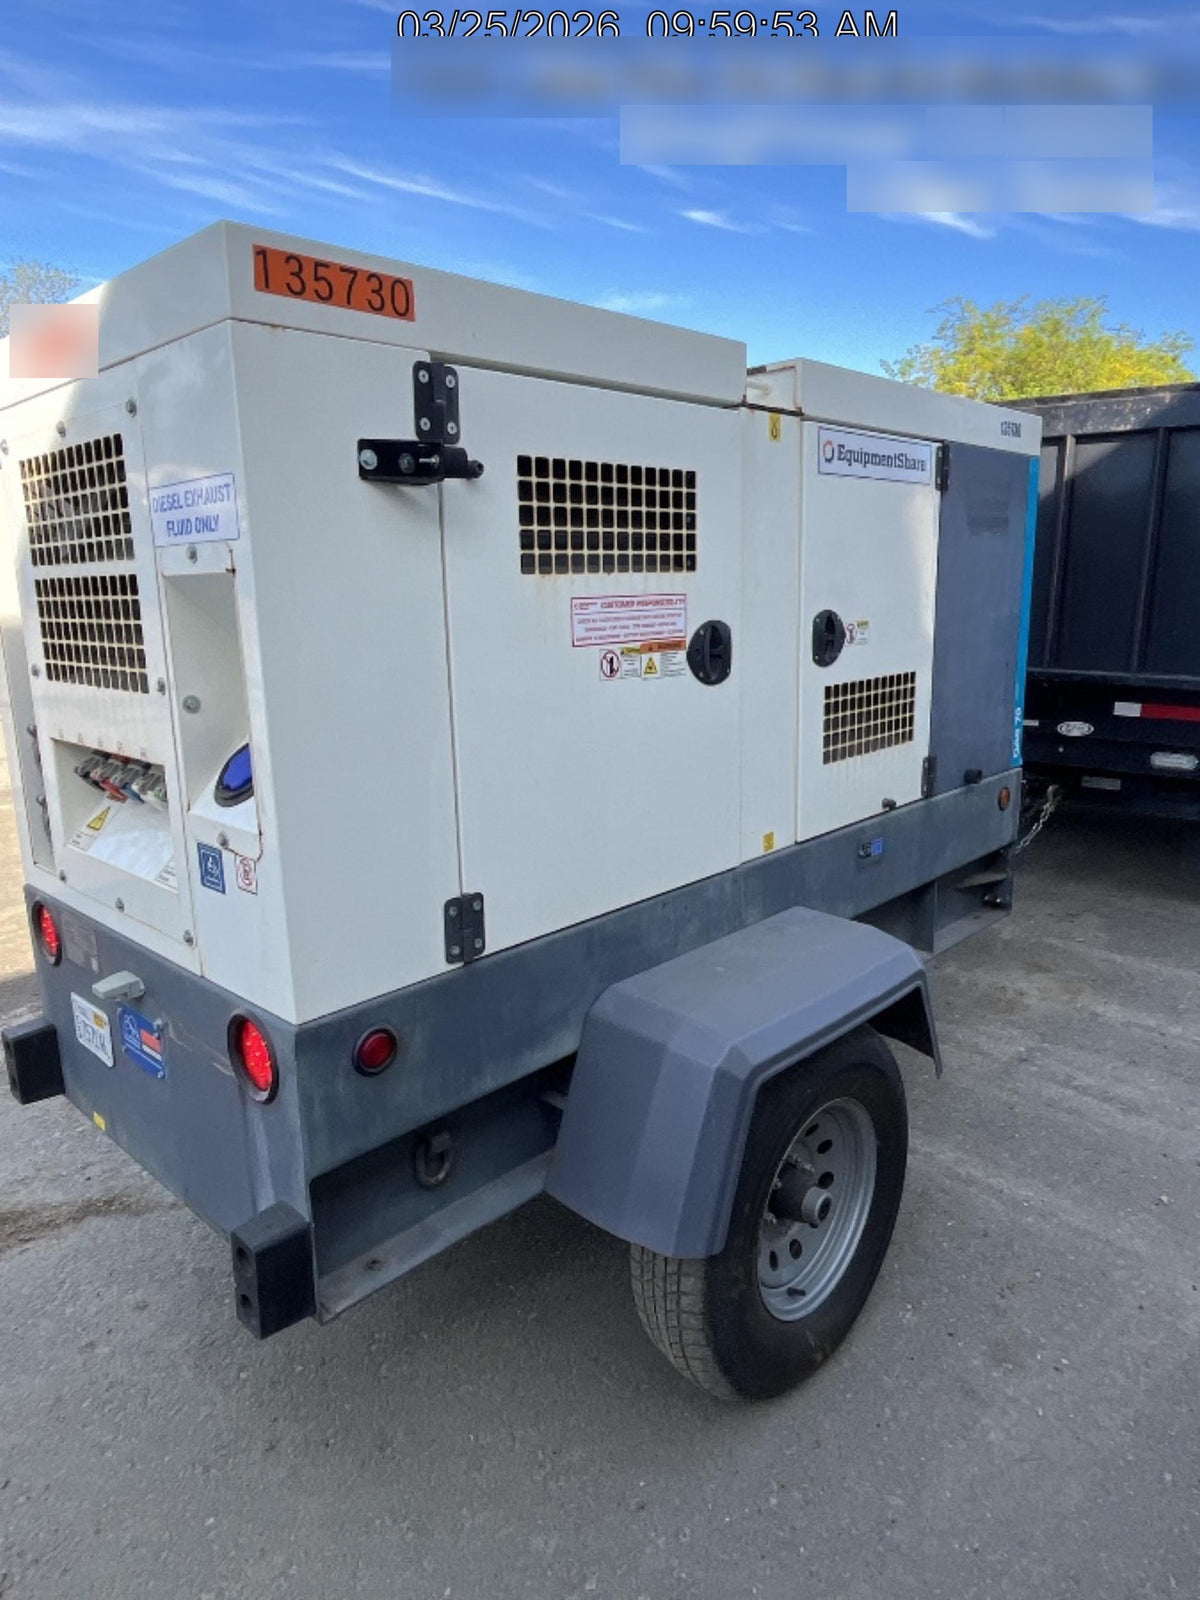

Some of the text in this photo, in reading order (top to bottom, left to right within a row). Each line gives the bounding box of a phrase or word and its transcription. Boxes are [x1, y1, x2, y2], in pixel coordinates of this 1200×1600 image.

[254, 248, 411, 318] 135730
[836, 444, 928, 472] EquipmentShare
[152, 482, 231, 513] DIESEL EXHAUST
[166, 513, 220, 537] FLUID ONLY
